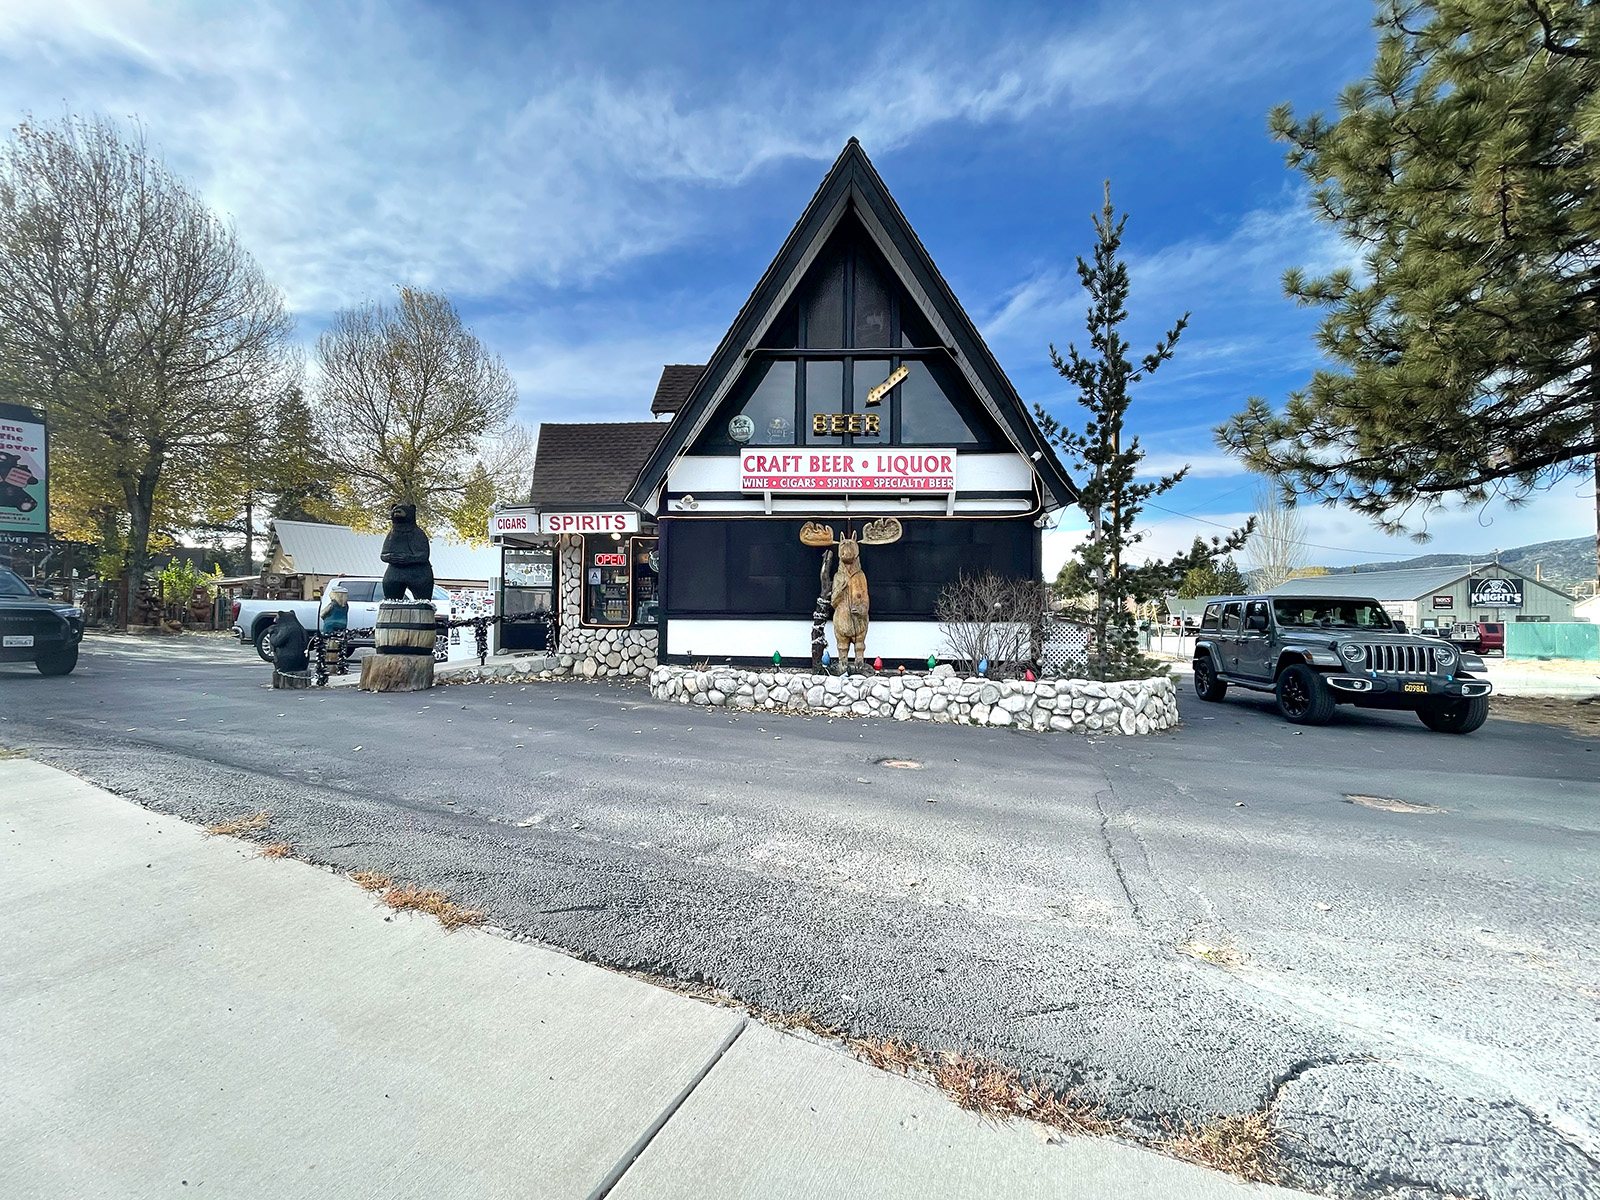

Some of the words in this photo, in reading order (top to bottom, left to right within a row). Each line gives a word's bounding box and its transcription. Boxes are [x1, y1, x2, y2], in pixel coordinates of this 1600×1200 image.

[0, 425, 23, 433] me
[813, 413, 881, 434] BEER
[743, 455, 802, 473] CRAFT
[809, 455, 855, 473] BEER
[877, 455, 953, 475] LIQUOR
[742, 478, 769, 488] WINE
[780, 478, 816, 488] CIGARS
[827, 478, 863, 488] SPIRITS
[873, 478, 926, 488] SPECIALTY
[929, 478, 954, 488] BEER
[497, 517, 527, 530] CIGARS
[549, 515, 626, 531] SPIRITS
[596, 554, 625, 566] OPEN
[591, 571, 598, 579] A
[1471, 593, 1522, 603] KNIGHT'S
